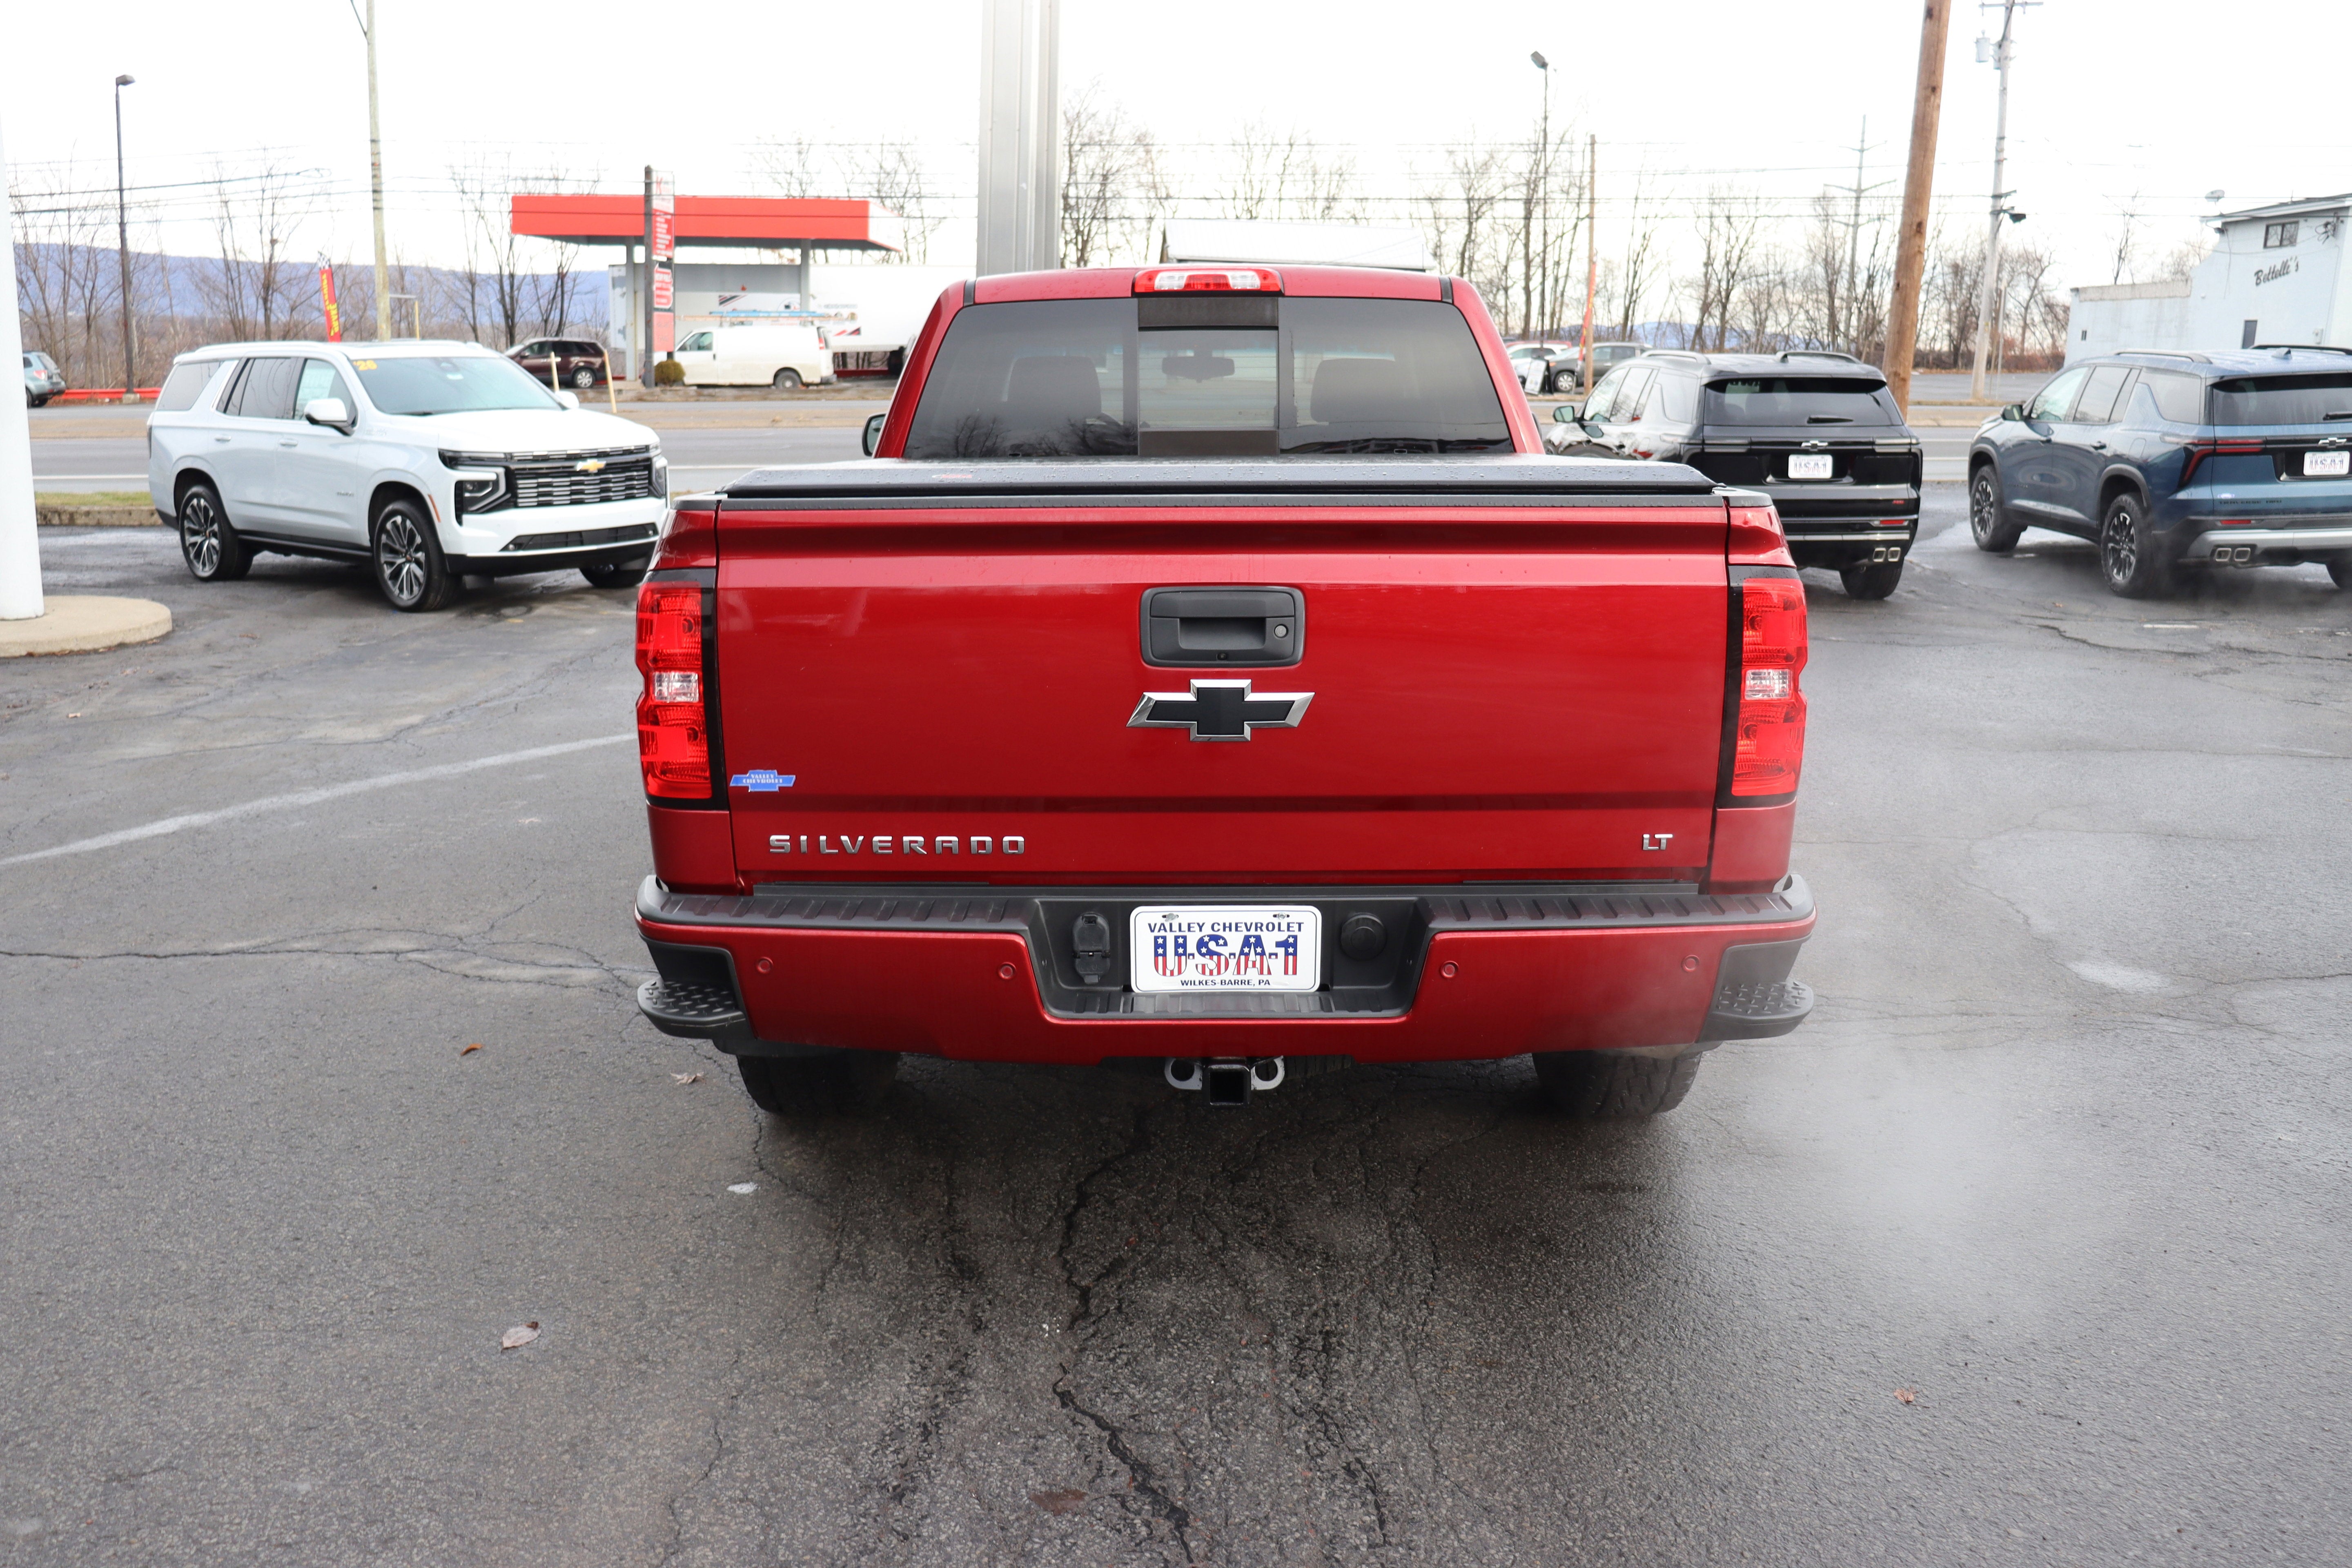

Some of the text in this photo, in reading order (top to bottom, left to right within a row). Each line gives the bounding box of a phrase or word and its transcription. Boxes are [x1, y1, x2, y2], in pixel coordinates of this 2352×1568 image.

[770, 835, 1025, 855] SILVERADO
[1643, 834, 1673, 851] LT
[1148, 922, 1304, 933] VALLEY CHEVROLET
